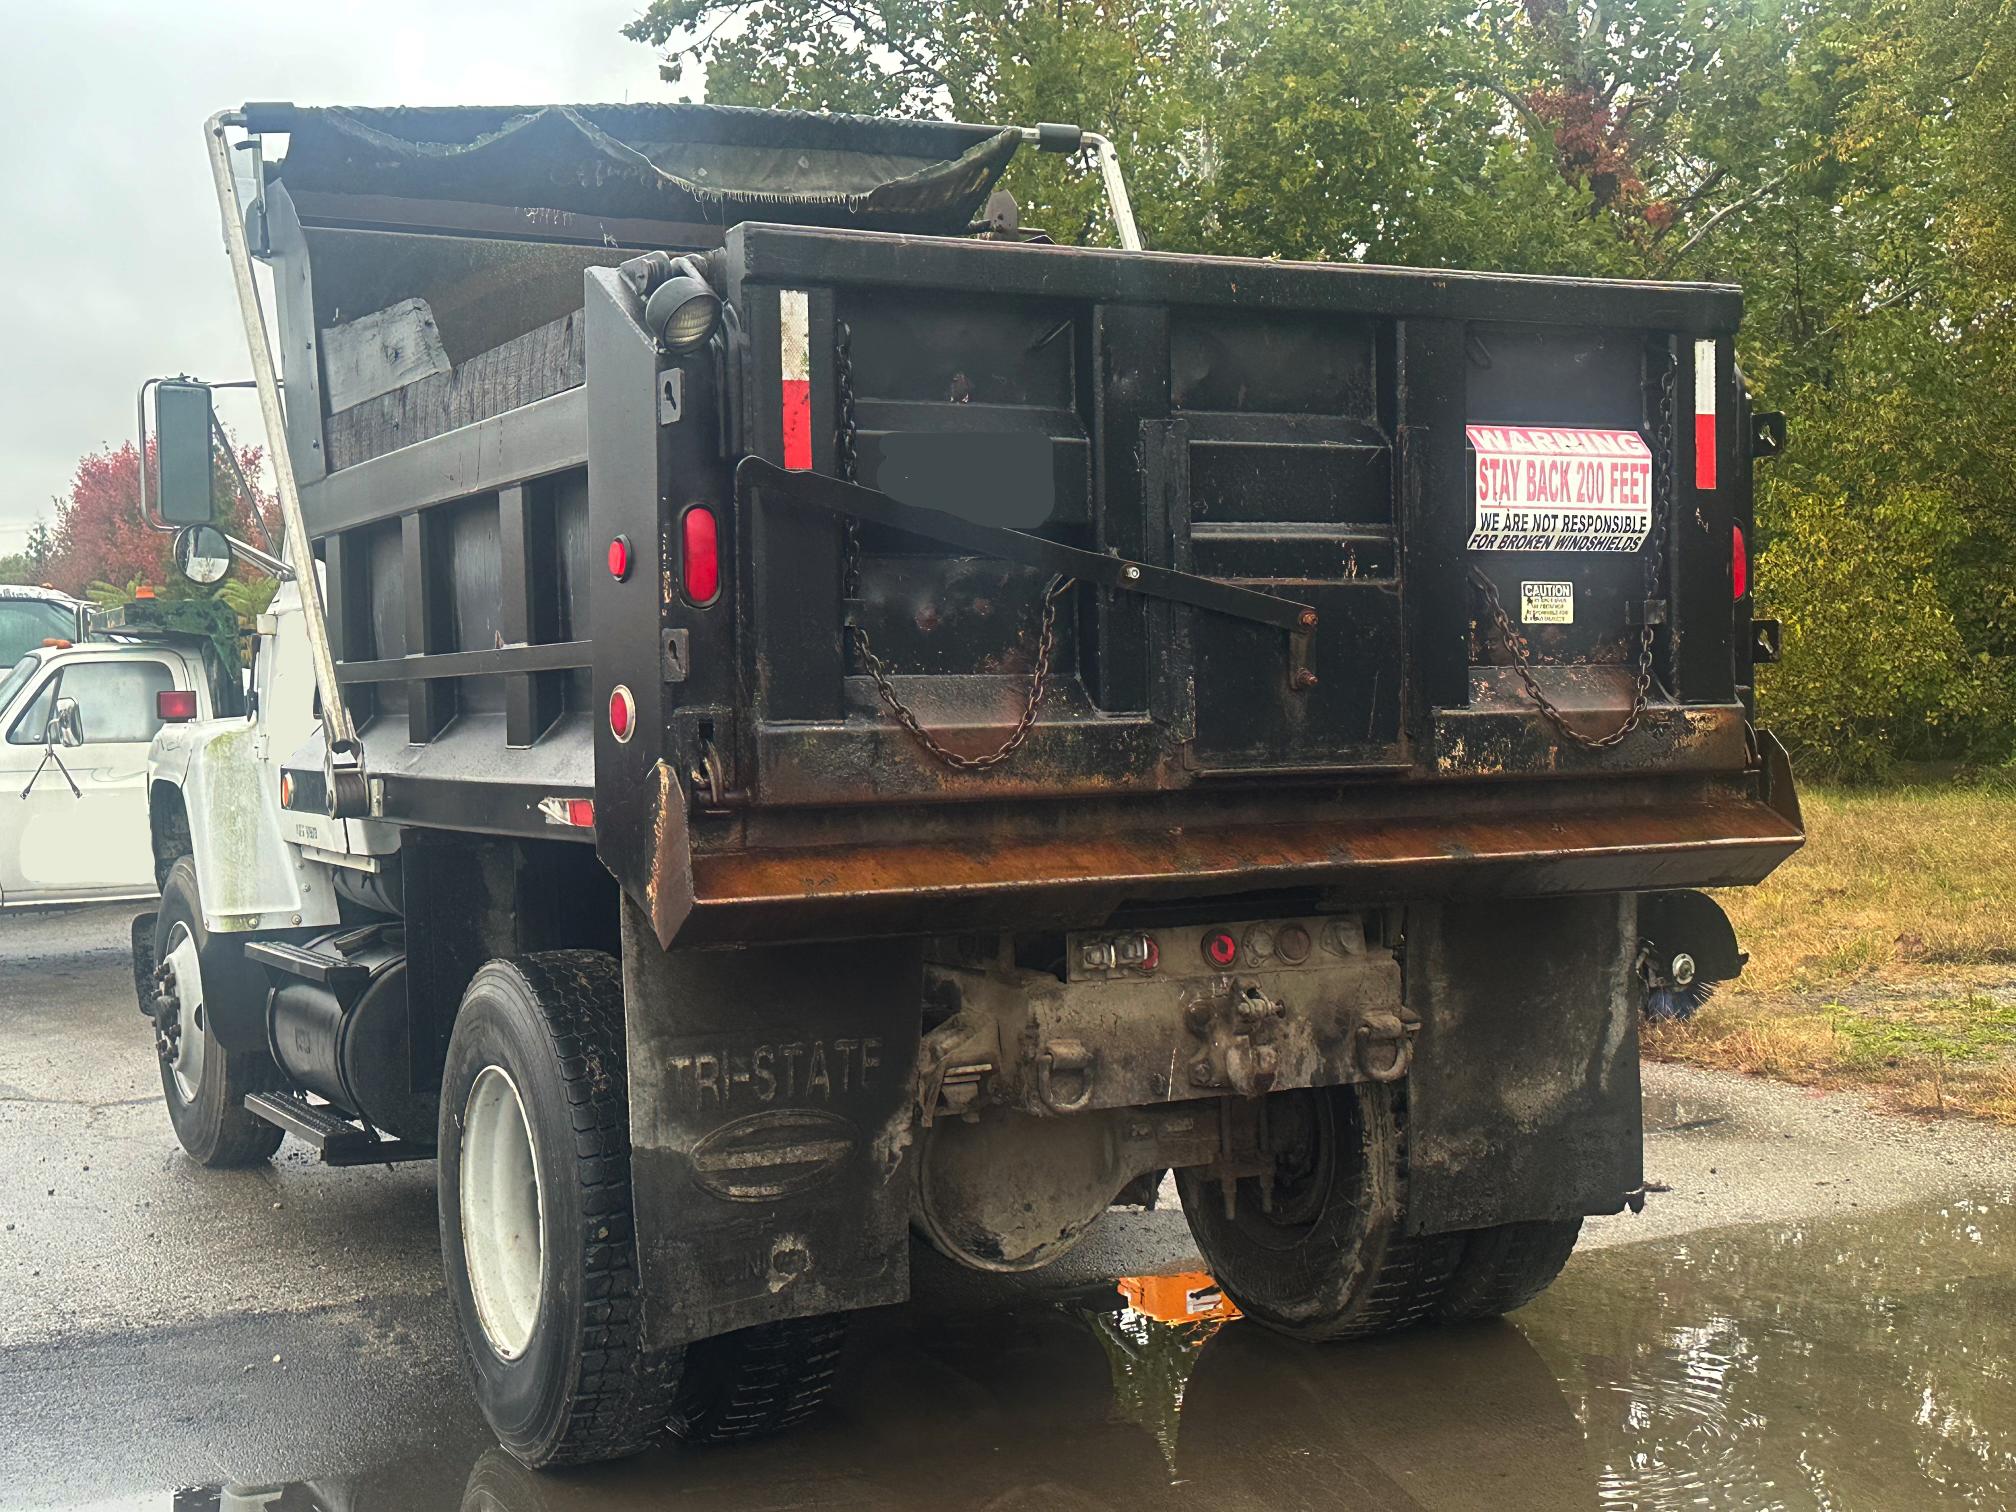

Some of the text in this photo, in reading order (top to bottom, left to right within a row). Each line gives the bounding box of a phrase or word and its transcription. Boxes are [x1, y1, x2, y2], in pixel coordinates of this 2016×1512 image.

[1469, 428, 1645, 454] WARNING
[1479, 458, 1650, 504] STAY BACK 200 FEET
[1480, 512, 1647, 534] WE ARE NOT RESPONSIBLE
[1467, 534, 1642, 552] FOR BROKEN WINDSHIELDS
[1524, 584, 1570, 597] CAUTION
